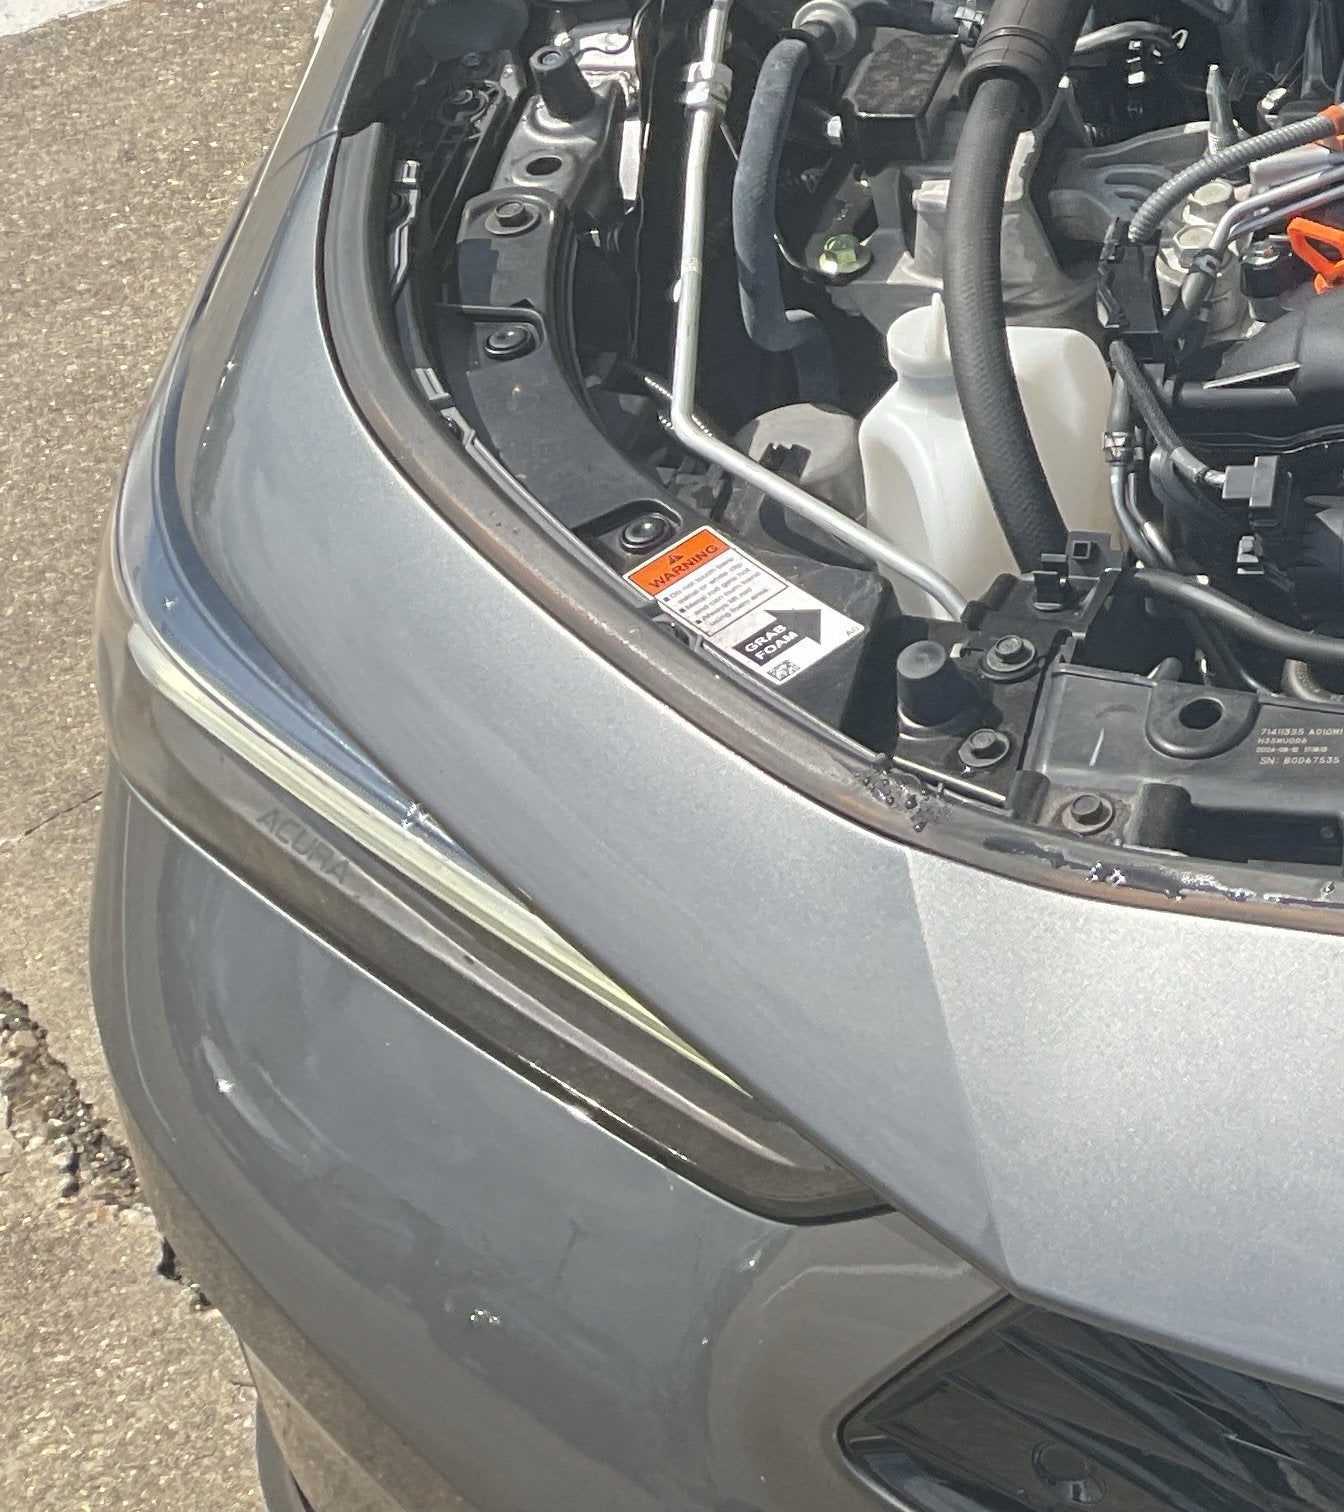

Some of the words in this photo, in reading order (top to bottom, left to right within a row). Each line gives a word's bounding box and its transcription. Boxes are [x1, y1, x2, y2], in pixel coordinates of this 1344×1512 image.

[650, 544, 718, 588] WARNING
[708, 571, 729, 585] white
[670, 589, 683, 599] Do
[695, 568, 716, 583] touch
[702, 603, 729, 621] Always
[744, 624, 787, 653] GRAB
[754, 630, 799, 660] FOAM
[255, 807, 350, 885] ACURA
